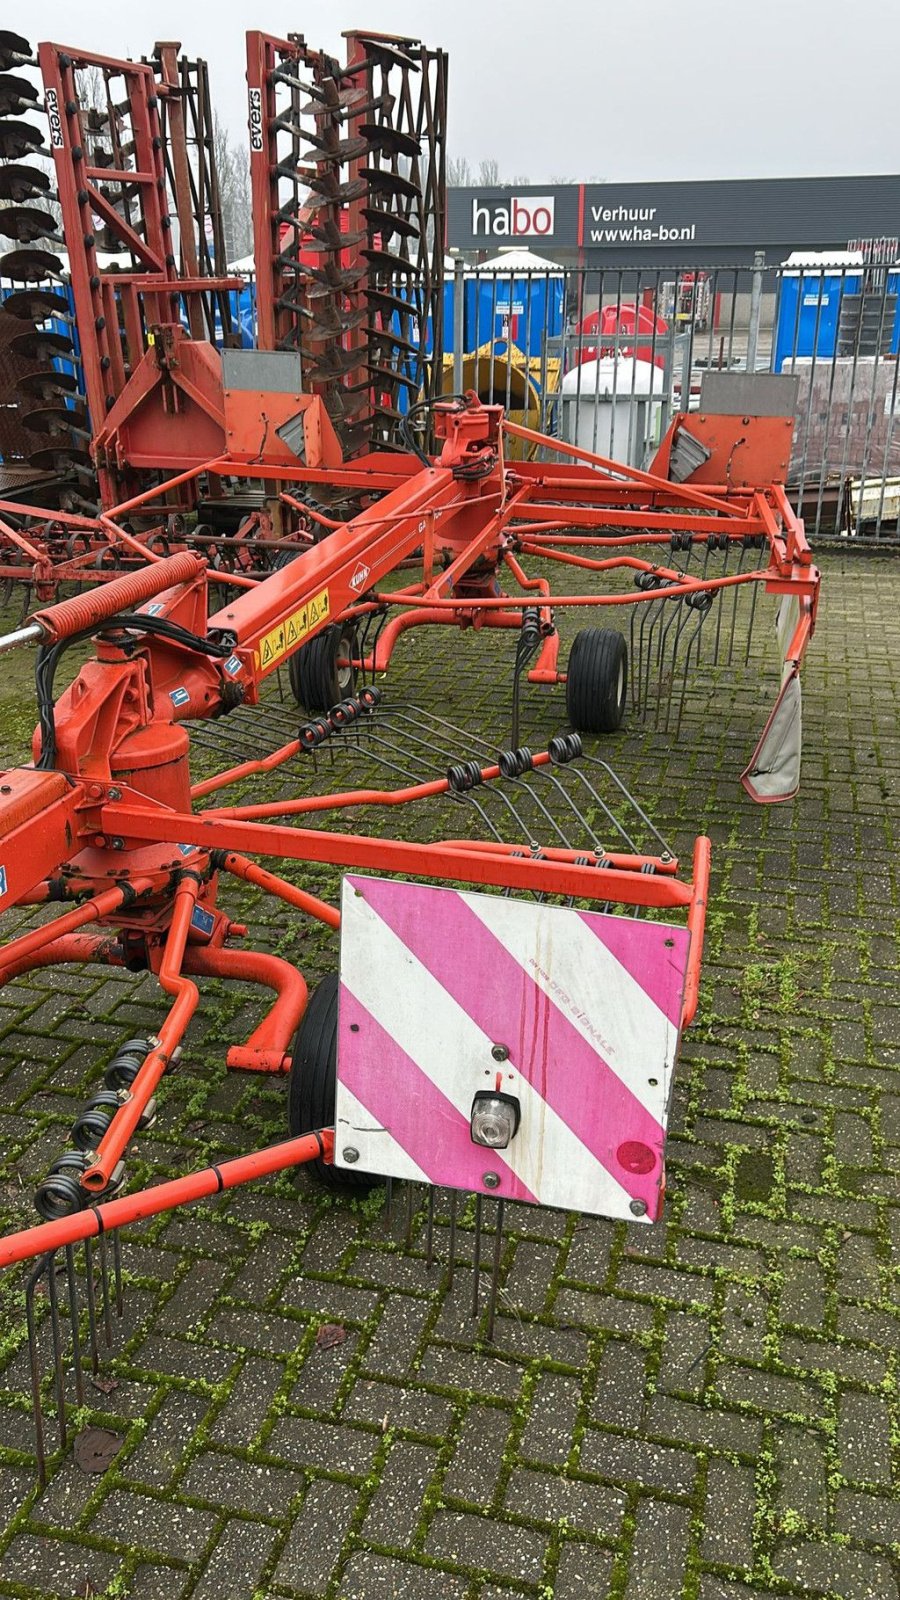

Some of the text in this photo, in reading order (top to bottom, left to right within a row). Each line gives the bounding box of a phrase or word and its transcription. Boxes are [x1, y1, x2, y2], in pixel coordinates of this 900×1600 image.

[46, 89, 63, 146] evers
[249, 90, 263, 150] evers
[472, 198, 552, 236] habo
[591, 205, 657, 222] Verhuur
[590, 224, 696, 242] www.ha-bo.nl
